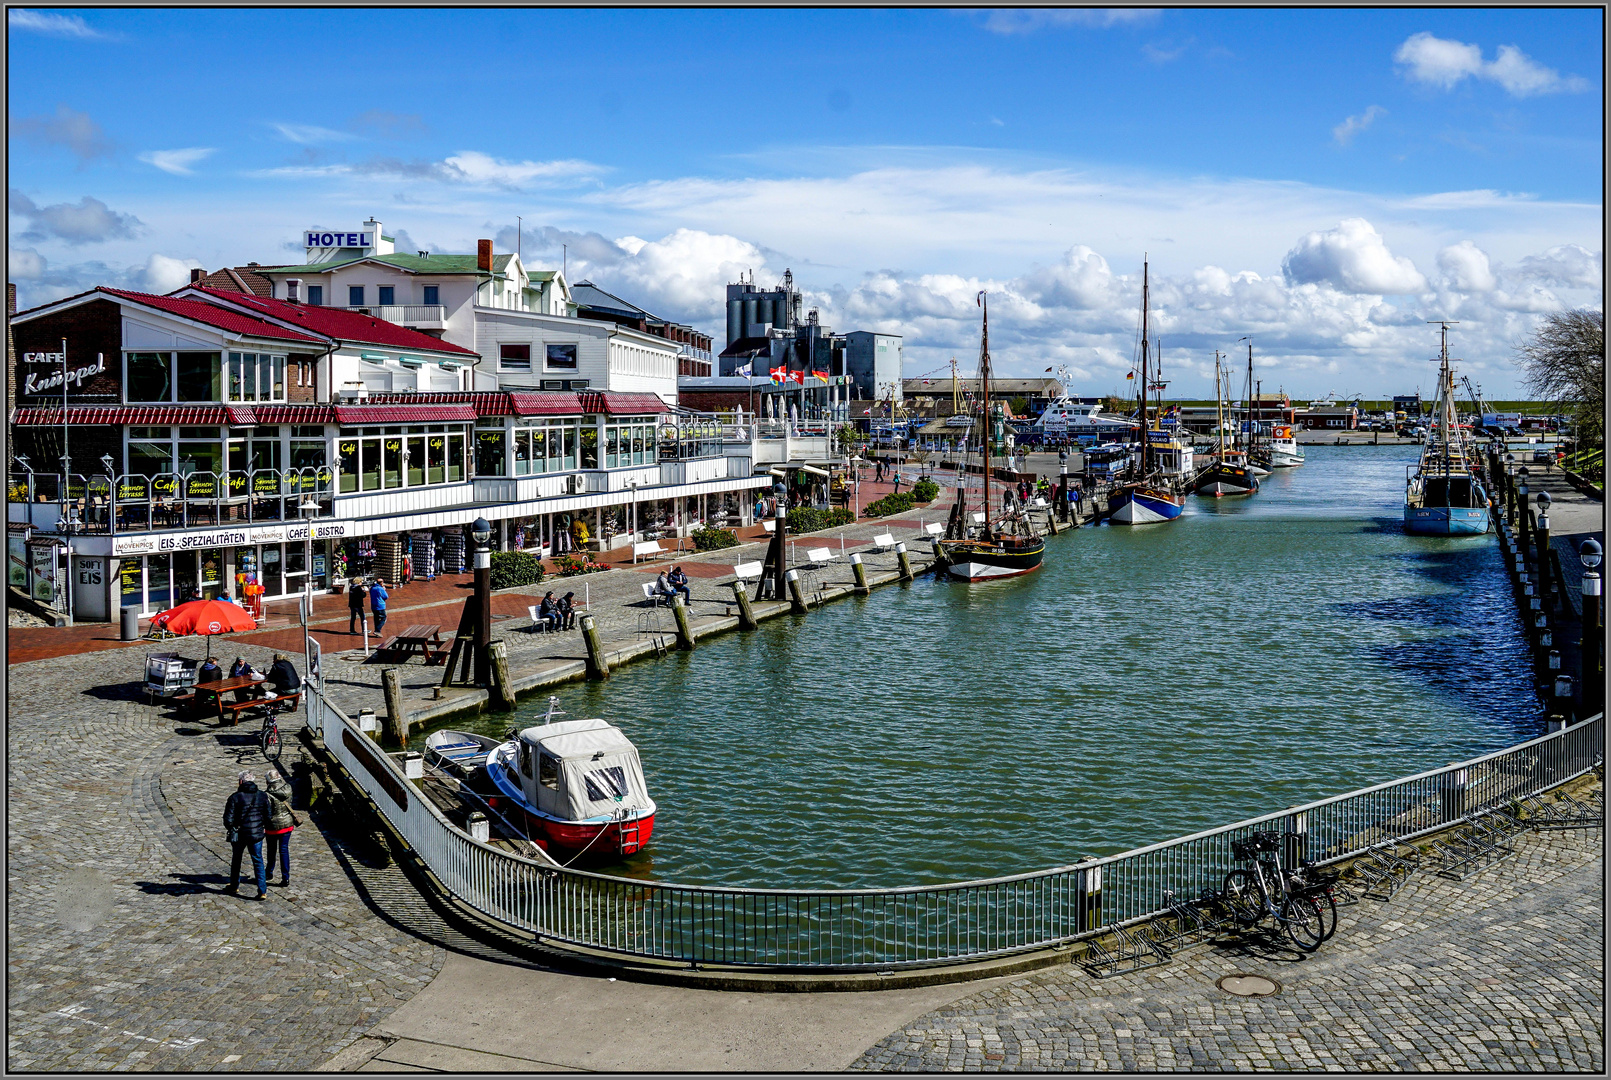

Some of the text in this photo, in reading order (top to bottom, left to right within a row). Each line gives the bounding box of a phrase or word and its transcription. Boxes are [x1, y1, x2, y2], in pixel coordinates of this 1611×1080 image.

[308, 233, 369, 246] HOTEL
[24, 353, 64, 362] CAFE
[25, 352, 106, 394] Knüppel
[480, 433, 500, 443] Café
[534, 432, 544, 441] Café
[580, 430, 597, 438] Café
[341, 443, 355, 455] Café
[386, 441, 399, 452] Café
[430, 438, 442, 450] Café
[222, 477, 246, 489] Café
[283, 474, 299, 486] Café
[317, 472, 332, 484] Café
[88, 482, 109, 494] Café
[154, 480, 180, 492] Café
[290, 526, 308, 538] CAFÉ
[318, 526, 344, 536] BISTRO
[118, 542, 154, 550] MÖVENPICK
[80, 560, 101, 570] SOFT
[80, 571, 102, 584] EIS
